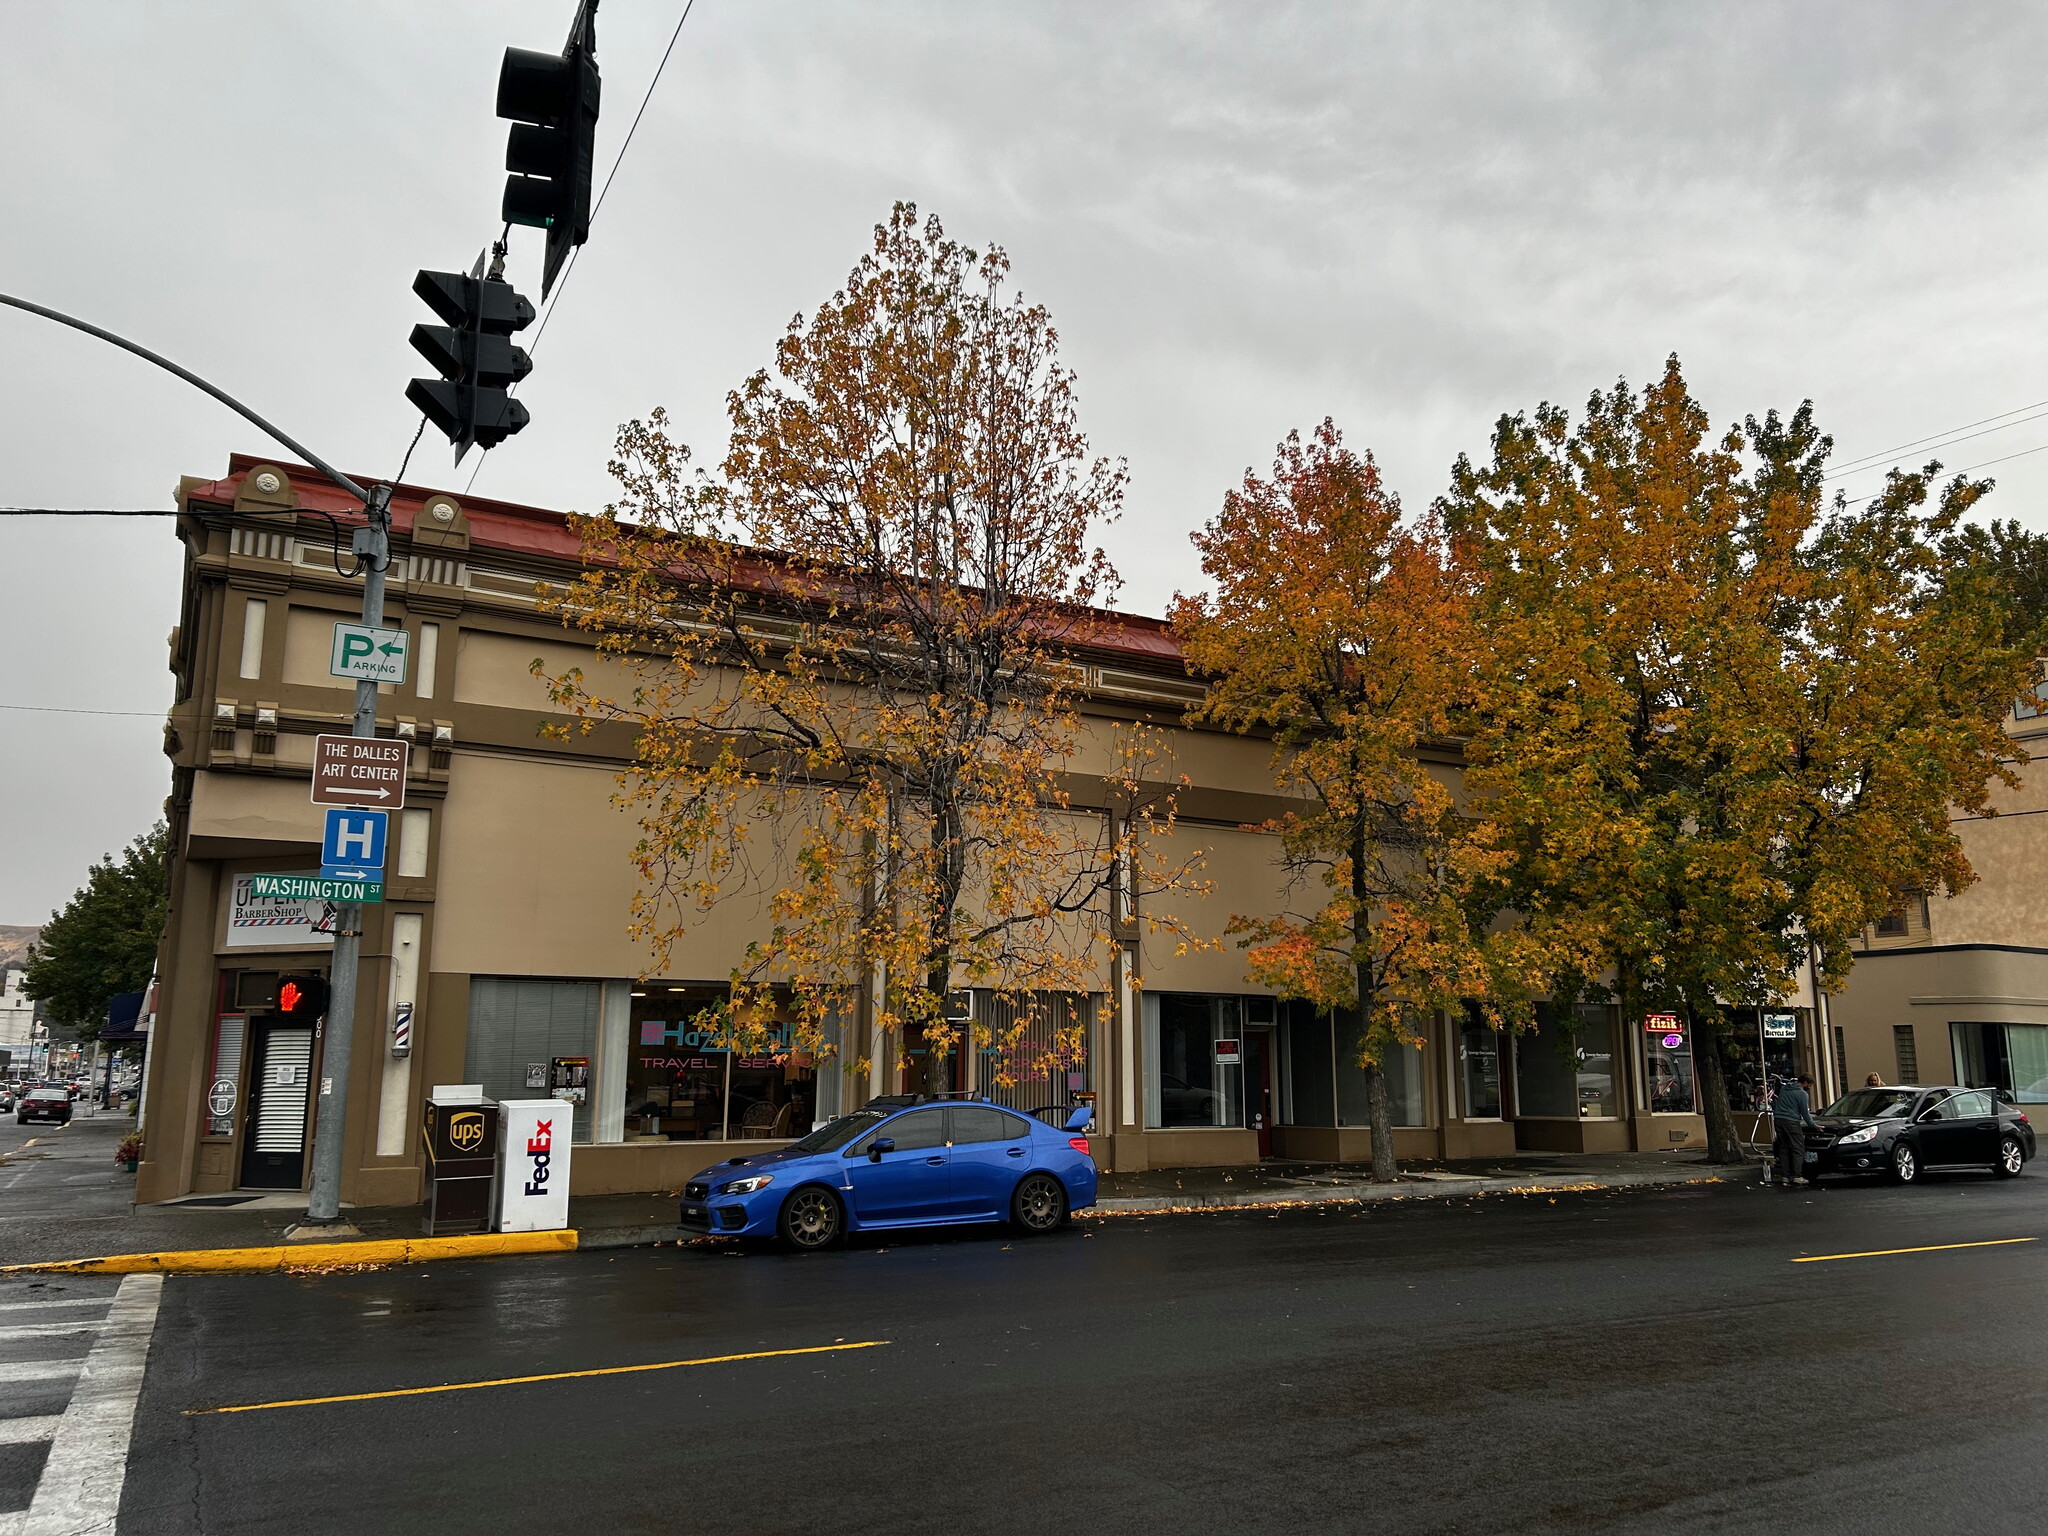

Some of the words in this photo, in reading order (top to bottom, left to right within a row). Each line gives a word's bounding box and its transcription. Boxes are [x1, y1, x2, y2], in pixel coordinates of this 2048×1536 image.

[325, 743, 349, 758] THE
[353, 745, 400, 762] DALLES
[321, 763, 347, 778] ART
[350, 765, 399, 781] CENTER
[336, 818, 374, 859] H
[255, 877, 365, 900] WASHINGTON
[370, 884, 381, 894] ST
[1650, 1017, 1678, 1029] fizik
[1769, 1019, 1793, 1030] SPR
[640, 1057, 718, 1069] TRAVEL
[738, 1058, 827, 1069] SERVIC
[217, 1083, 230, 1092] BY
[452, 1124, 482, 1146] ups
[524, 1118, 553, 1197] FedEx
